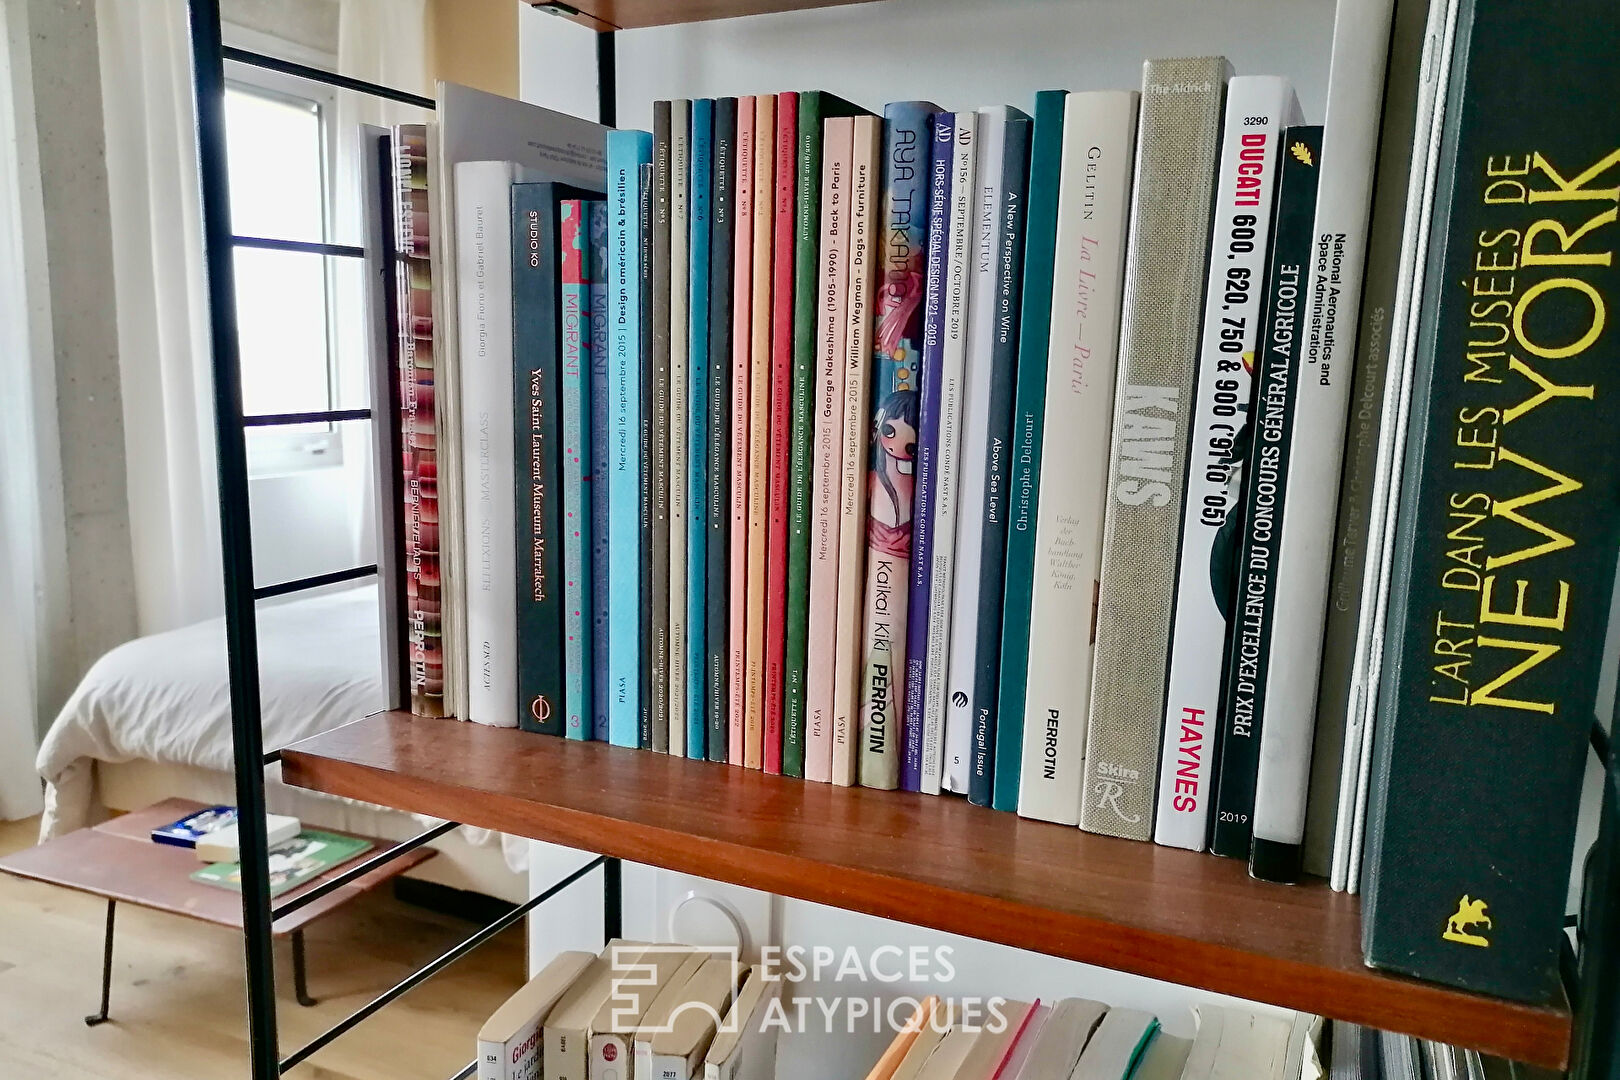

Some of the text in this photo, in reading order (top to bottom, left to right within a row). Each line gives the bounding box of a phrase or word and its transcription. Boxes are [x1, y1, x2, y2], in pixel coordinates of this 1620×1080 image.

[938, 124, 951, 142] AD
[959, 128, 971, 145] AD
[1243, 117, 1268, 125] 3290
[719, 140, 728, 190] L'ÉTIQUETTE
[894, 129, 916, 182] AYA
[1235, 134, 1266, 206] DUCATI
[932, 160, 946, 215] HORS-SÉRIE
[475, 207, 484, 239] Bauret
[530, 211, 539, 267] STUDIO KO
[931, 218, 944, 254] SPÉCIAL
[980, 187, 993, 272] ELEMENTUM
[1006, 205, 1016, 228] New
[476, 242, 484, 278] Gabriel
[930, 258, 940, 290] DESIGN
[952, 197, 966, 315] SEPTEMBRE/OCTOBRE
[1001, 233, 1015, 295] Perspective
[617, 169, 628, 470] Mercredi 16 septembre 2015 Design américain & brésilien
[1002, 299, 1009, 313] on
[1071, 236, 1099, 394] La Livre Paris
[1308, 234, 1333, 363] Space Administration
[1320, 233, 1347, 385] National Aeronautics and
[566, 293, 579, 378] MIGRANT
[593, 293, 606, 376] MIGRANT
[845, 165, 866, 515] Mercredi 16 septembre 2015 William Wegman Dogs on furniture
[927, 324, 936, 345] 2019
[951, 318, 960, 339] 2019
[1000, 316, 1010, 342] Wine
[659, 379, 664, 387] LE
[715, 377, 721, 385] LE
[819, 162, 840, 560] Mercredi 16 septembre 2015 George Nakashima (1905-1990) Back to Paris
[1200, 214, 1257, 527] 600, 620, 750 & 900 ('91 to '05)
[1358, 307, 1384, 419] Delcourt associés
[659, 417, 664, 426] DU
[715, 415, 720, 424] DE
[1115, 384, 1180, 506] KAWS
[1429, 154, 1530, 705] L'ART DANS LES MUSÉES DE
[1470, 147, 1620, 714] NEW YORK
[714, 428, 722, 471] L'ÉLÉGANCE
[1016, 412, 1033, 530] Christophe Delcourt
[530, 368, 545, 601] Yves Saint Laurent Museum Marrakech
[797, 474, 802, 484] DE
[920, 463, 929, 517] PUBLICATIONS
[989, 438, 1002, 523] Above Sea Level
[1233, 265, 1299, 736] PRIX D'EXCELLENCE DU CONCOURS GÉNÉRAL AGRICOLE
[797, 514, 802, 522] LE
[874, 561, 893, 651] Kaikai Kiki
[618, 677, 626, 703] PIASA
[869, 664, 888, 753] PERROTIN
[571, 715, 580, 728] 3
[813, 709, 821, 737] PIASA
[837, 716, 845, 743] PIASA
[976, 709, 988, 775] Portugal Issue
[1043, 709, 1059, 779] PERROTIN
[1174, 707, 1205, 812] HAYNES
[1220, 812, 1248, 824] 2019
